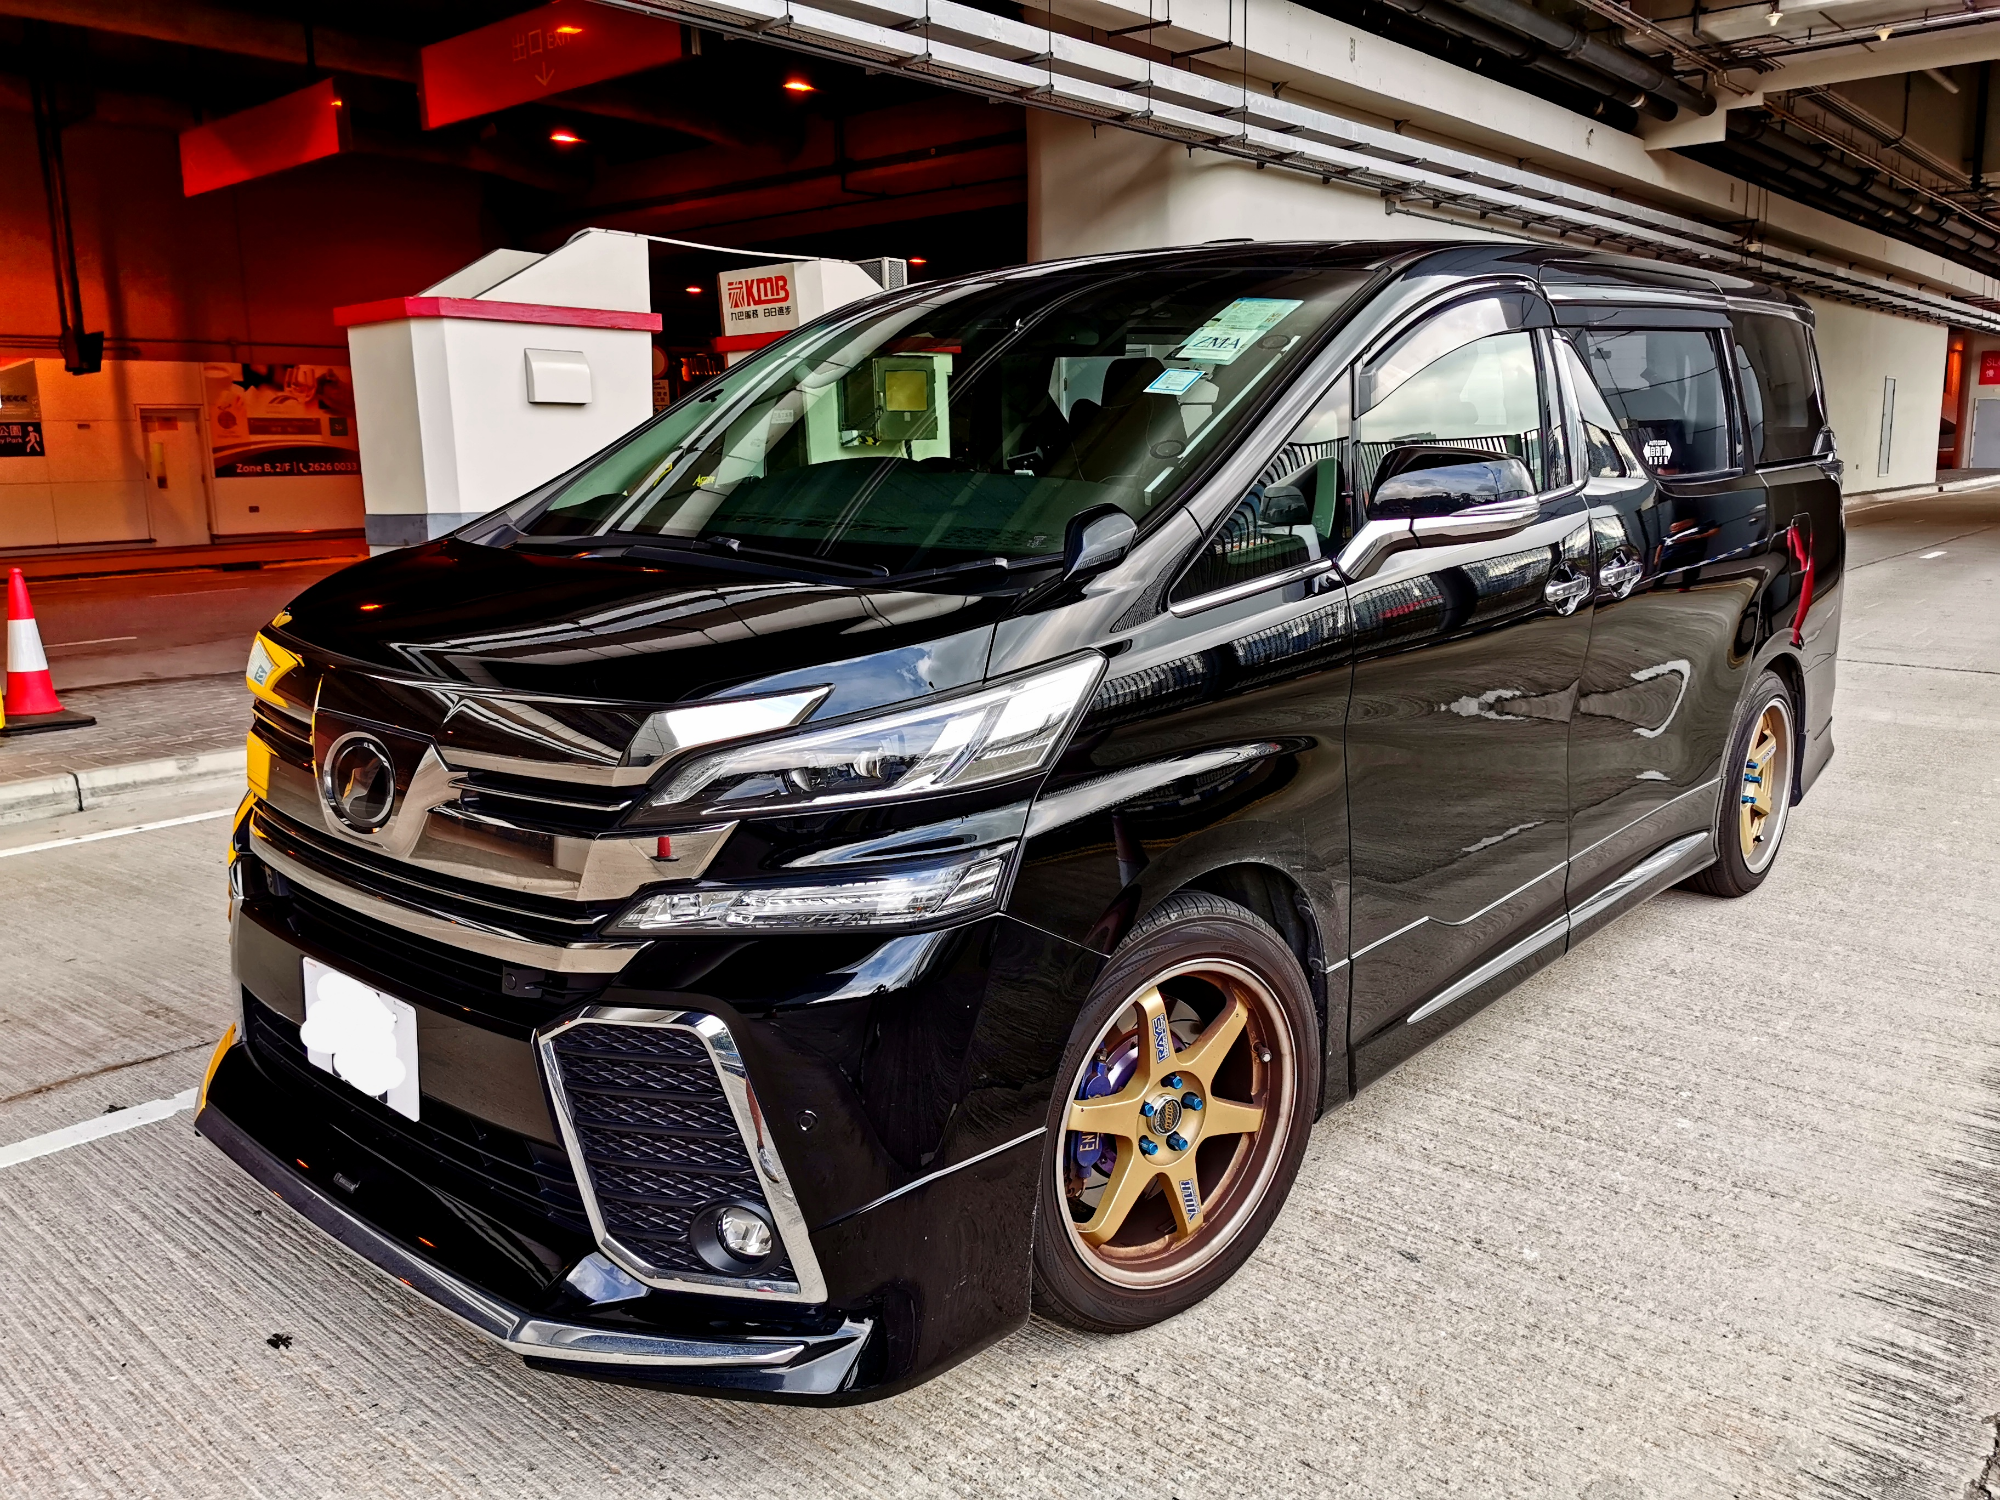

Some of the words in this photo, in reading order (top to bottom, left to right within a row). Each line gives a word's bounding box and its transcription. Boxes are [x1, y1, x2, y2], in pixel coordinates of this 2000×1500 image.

[511, 29, 543, 63] 出口
[744, 275, 790, 307] KMB
[236, 463, 262, 473] Zone
[275, 462, 291, 472] 2/F
[308, 462, 332, 472] 2626
[334, 462, 358, 471] 0033
